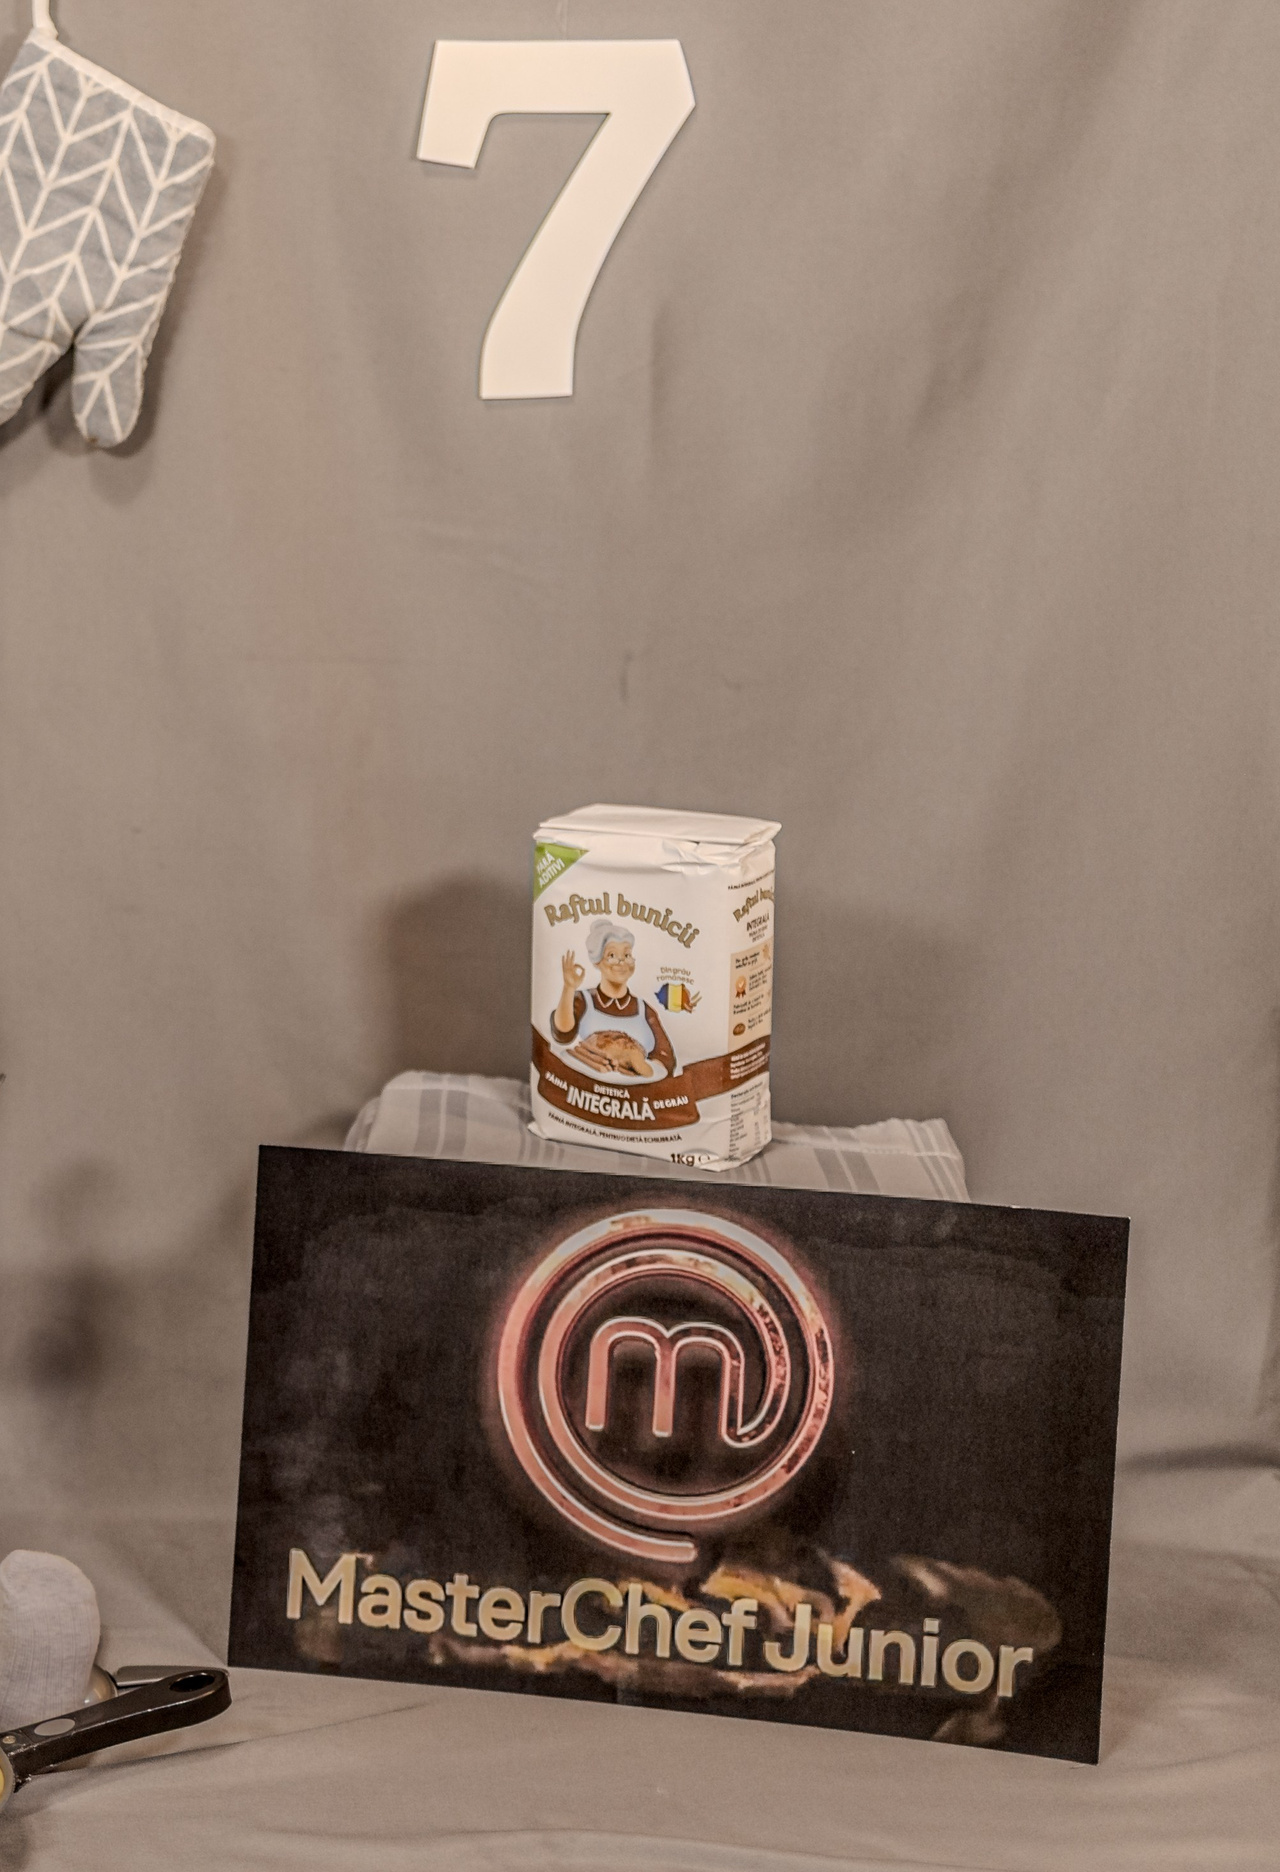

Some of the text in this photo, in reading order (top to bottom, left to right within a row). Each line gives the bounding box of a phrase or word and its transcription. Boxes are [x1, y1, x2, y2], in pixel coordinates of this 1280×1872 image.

[416, 38, 697, 400] 7
[537, 857, 566, 888] ADITIVI
[543, 891, 701, 949] Raftul bunicii
[565, 1085, 656, 1122] INTEGRALĂ
[284, 1546, 1035, 1699] MasterChef Junior
